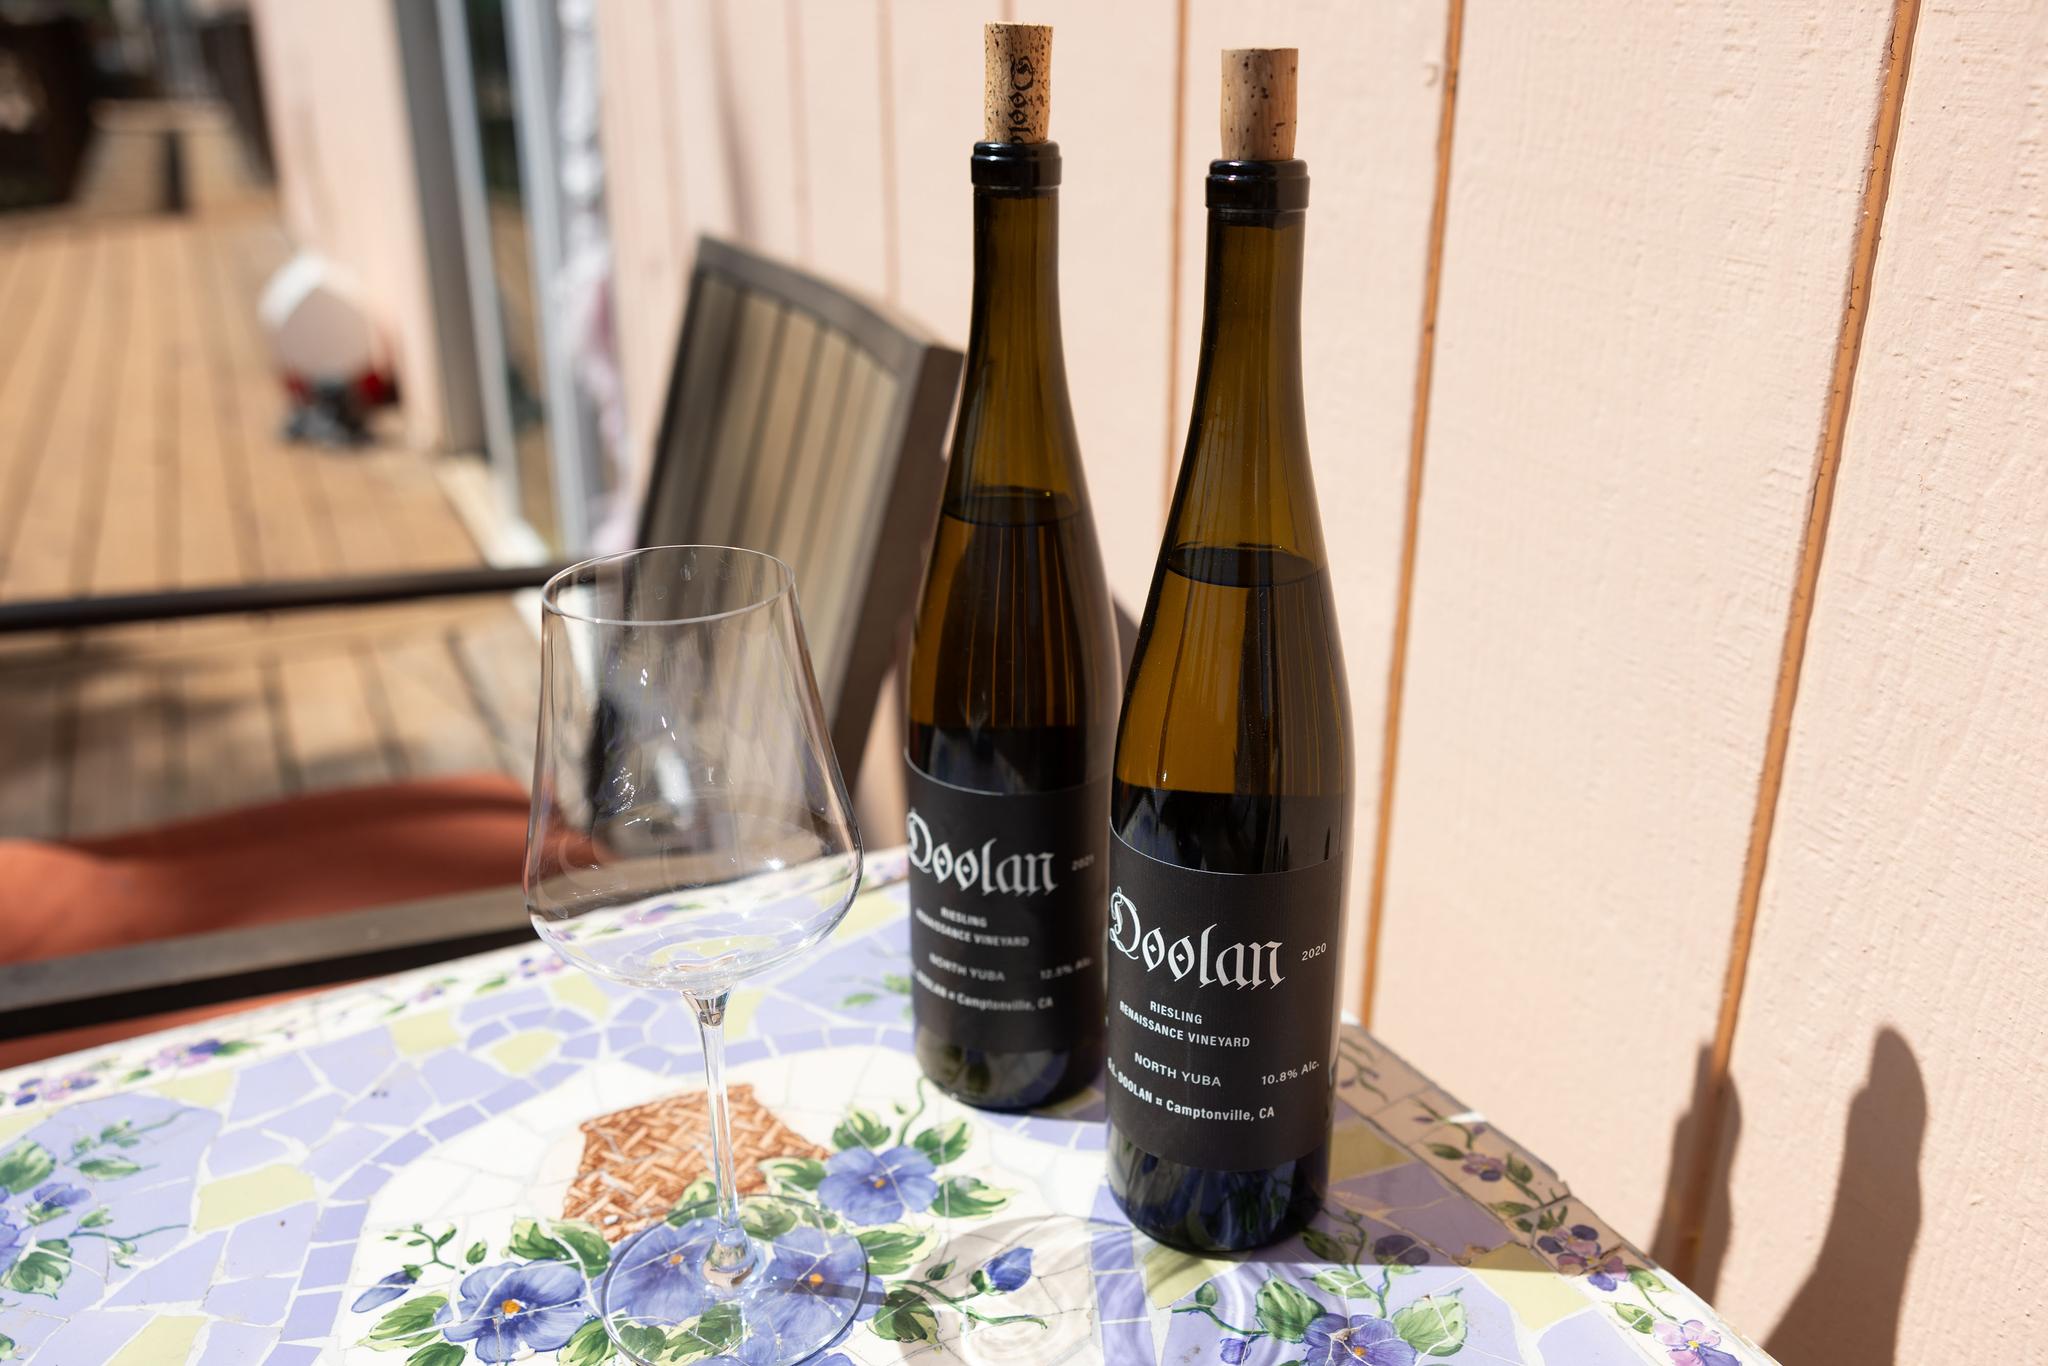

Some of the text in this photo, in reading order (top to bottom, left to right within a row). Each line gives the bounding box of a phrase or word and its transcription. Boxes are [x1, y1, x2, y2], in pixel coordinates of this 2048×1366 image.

[907, 808, 1057, 896] Doolan
[940, 906, 987, 928] RIESLING
[973, 932, 1029, 946] VINEYARD
[1109, 885, 1286, 991] Doolan
[1301, 942, 1327, 961] 2020
[929, 952, 967, 976] NORTH
[970, 967, 1005, 981] YUBA
[1038, 996, 1053, 1009] CA
[1150, 1000, 1203, 1024] RIESLING
[1119, 1000, 1250, 1047] RENAISSANCE VINEYARD
[1134, 1052, 1222, 1087] NORTH YUBA
[1261, 1059, 1320, 1086] 10.8% Alc.
[1118, 1071, 1152, 1103] DOOLAN
[1166, 1099, 1254, 1121] Camptonville,
[1259, 1105, 1275, 1119] CA
